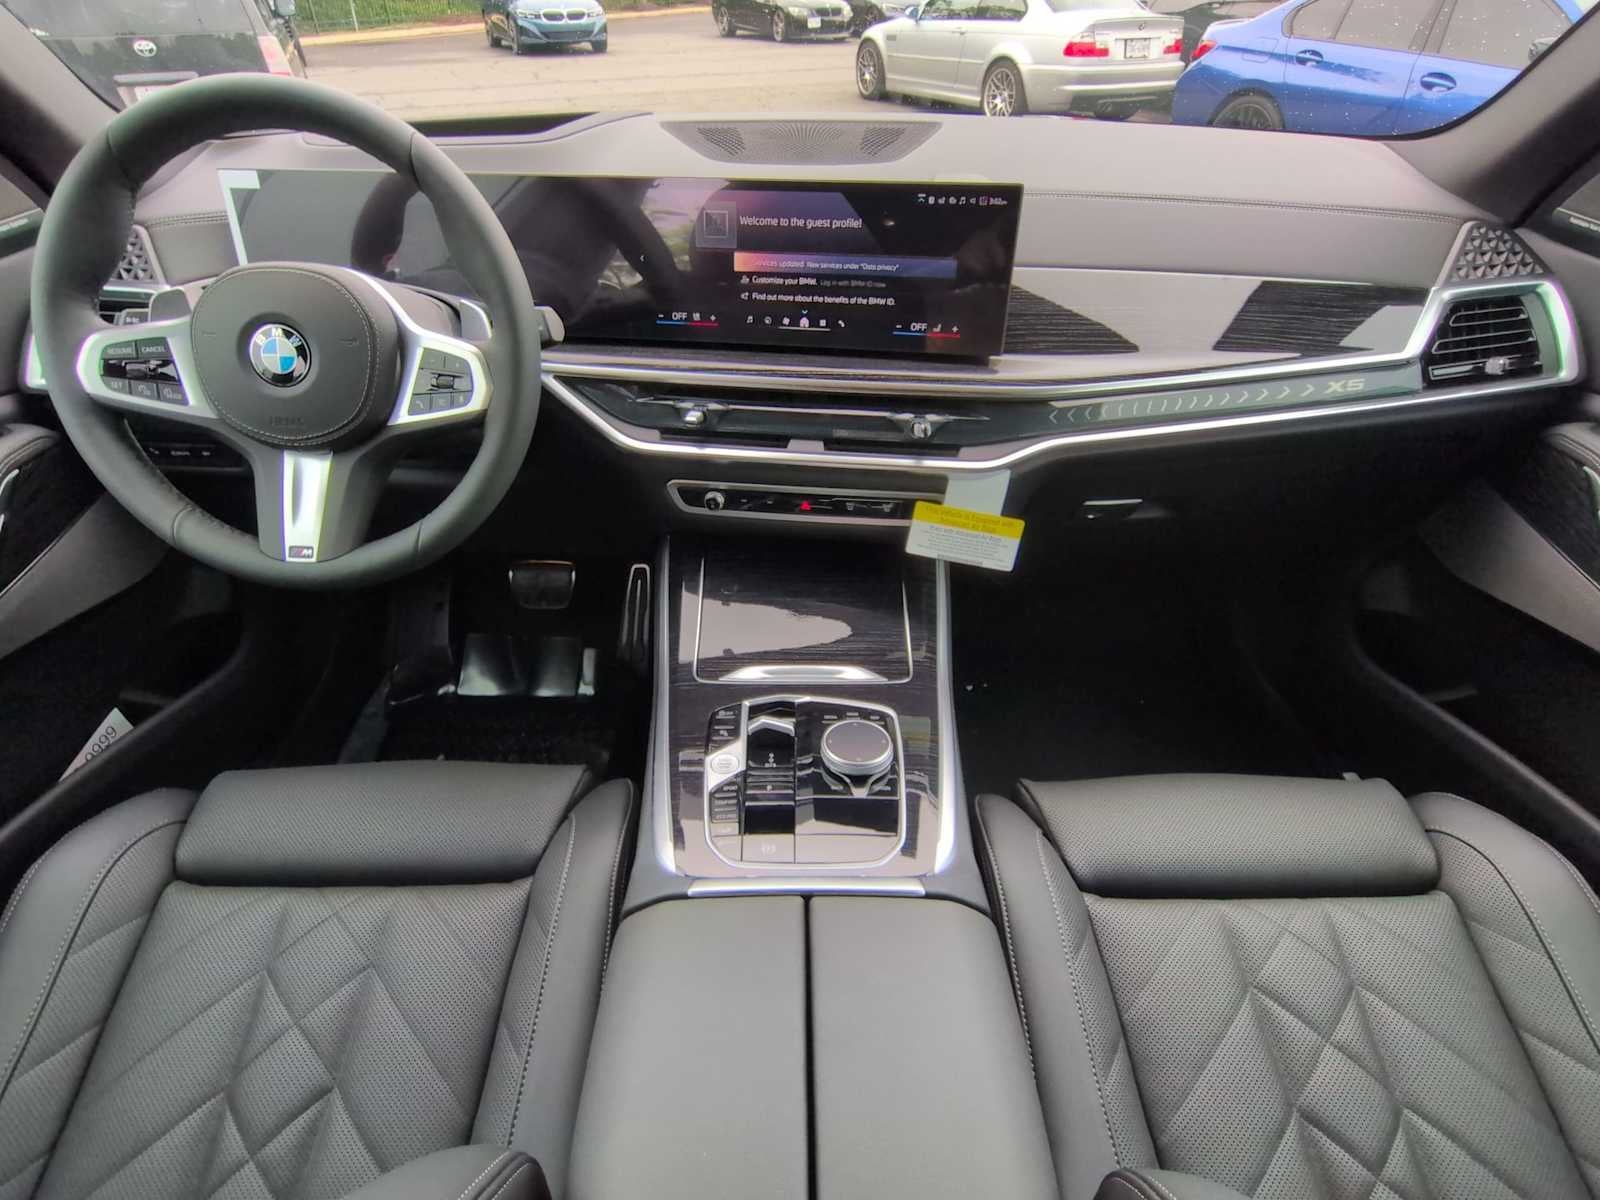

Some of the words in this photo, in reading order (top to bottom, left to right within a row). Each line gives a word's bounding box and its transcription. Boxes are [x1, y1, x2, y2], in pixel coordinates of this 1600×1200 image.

[739, 215, 779, 226] Welcome
[780, 217, 789, 226] to
[790, 217, 805, 227] the
[806, 218, 831, 229] guest
[832, 217, 863, 229] profile!
[752, 275, 784, 284] Customize
[784, 278, 799, 286] your
[752, 291, 766, 301] Find
[767, 293, 777, 301] out
[777, 294, 794, 302] more
[794, 294, 813, 303] about
[813, 295, 824, 303] the
[824, 296, 849, 304] benefits
[849, 296, 857, 304] of
[857, 296, 868, 305] the
[868, 297, 887, 305] BMW
[671, 311, 688, 321] OFF
[910, 322, 928, 332] OFF
[255, 326, 303, 347] BMW
[141, 344, 166, 353] CANCEL
